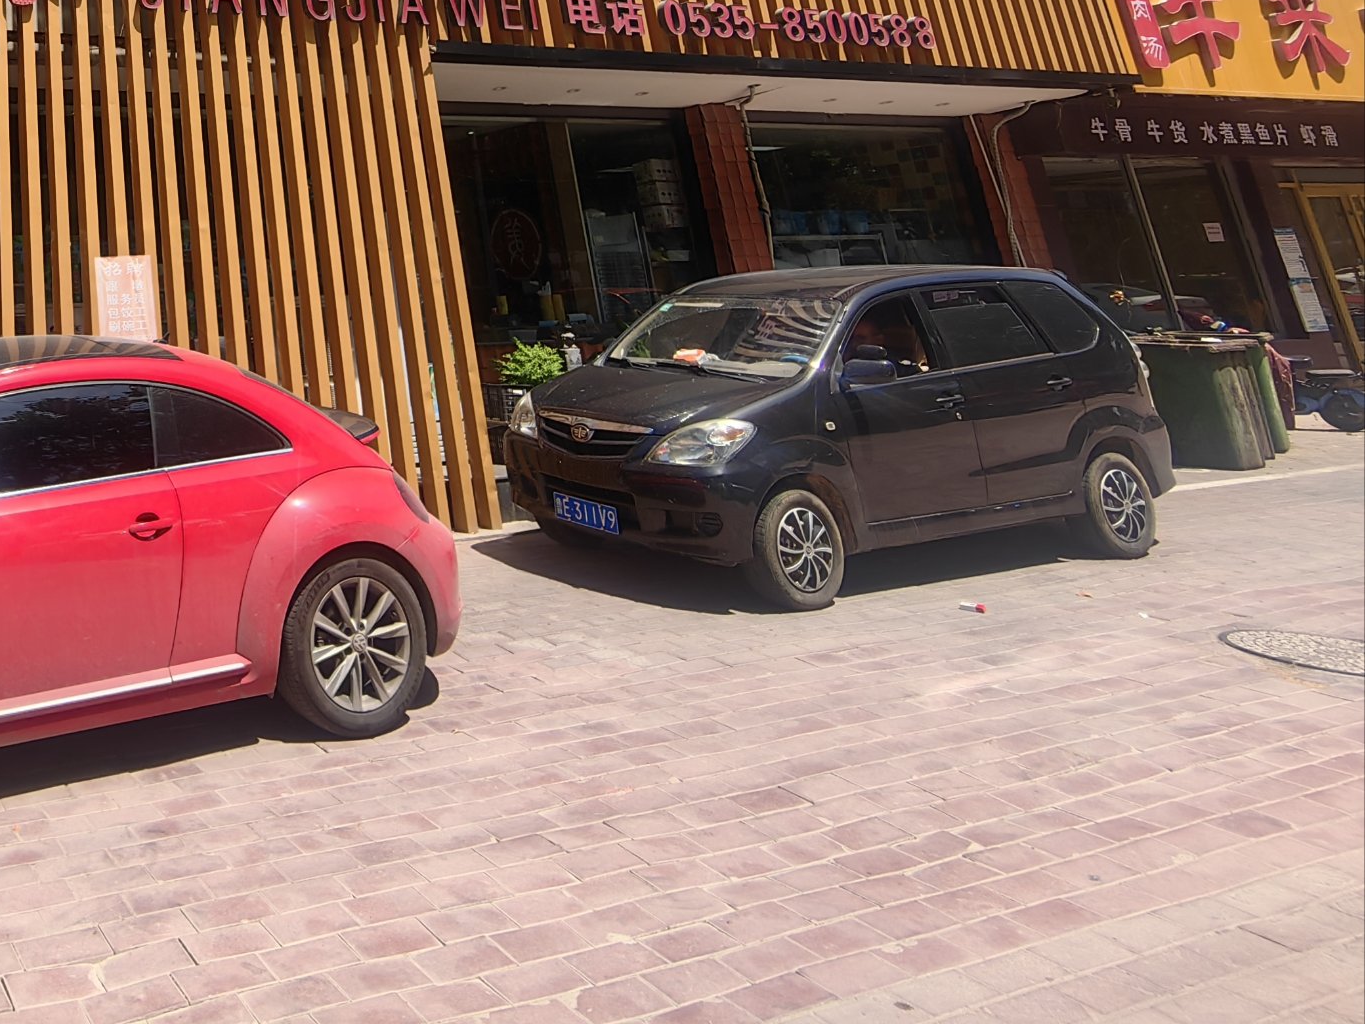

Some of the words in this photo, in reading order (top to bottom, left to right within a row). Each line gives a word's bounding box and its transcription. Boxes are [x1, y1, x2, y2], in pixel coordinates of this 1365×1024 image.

[1090, 117, 1133, 143] 牛骨
[1147, 119, 1189, 144] 牛货
[1199, 121, 1290, 147] 水煮黑鱼片
[1299, 124, 1340, 148] 虾滑
